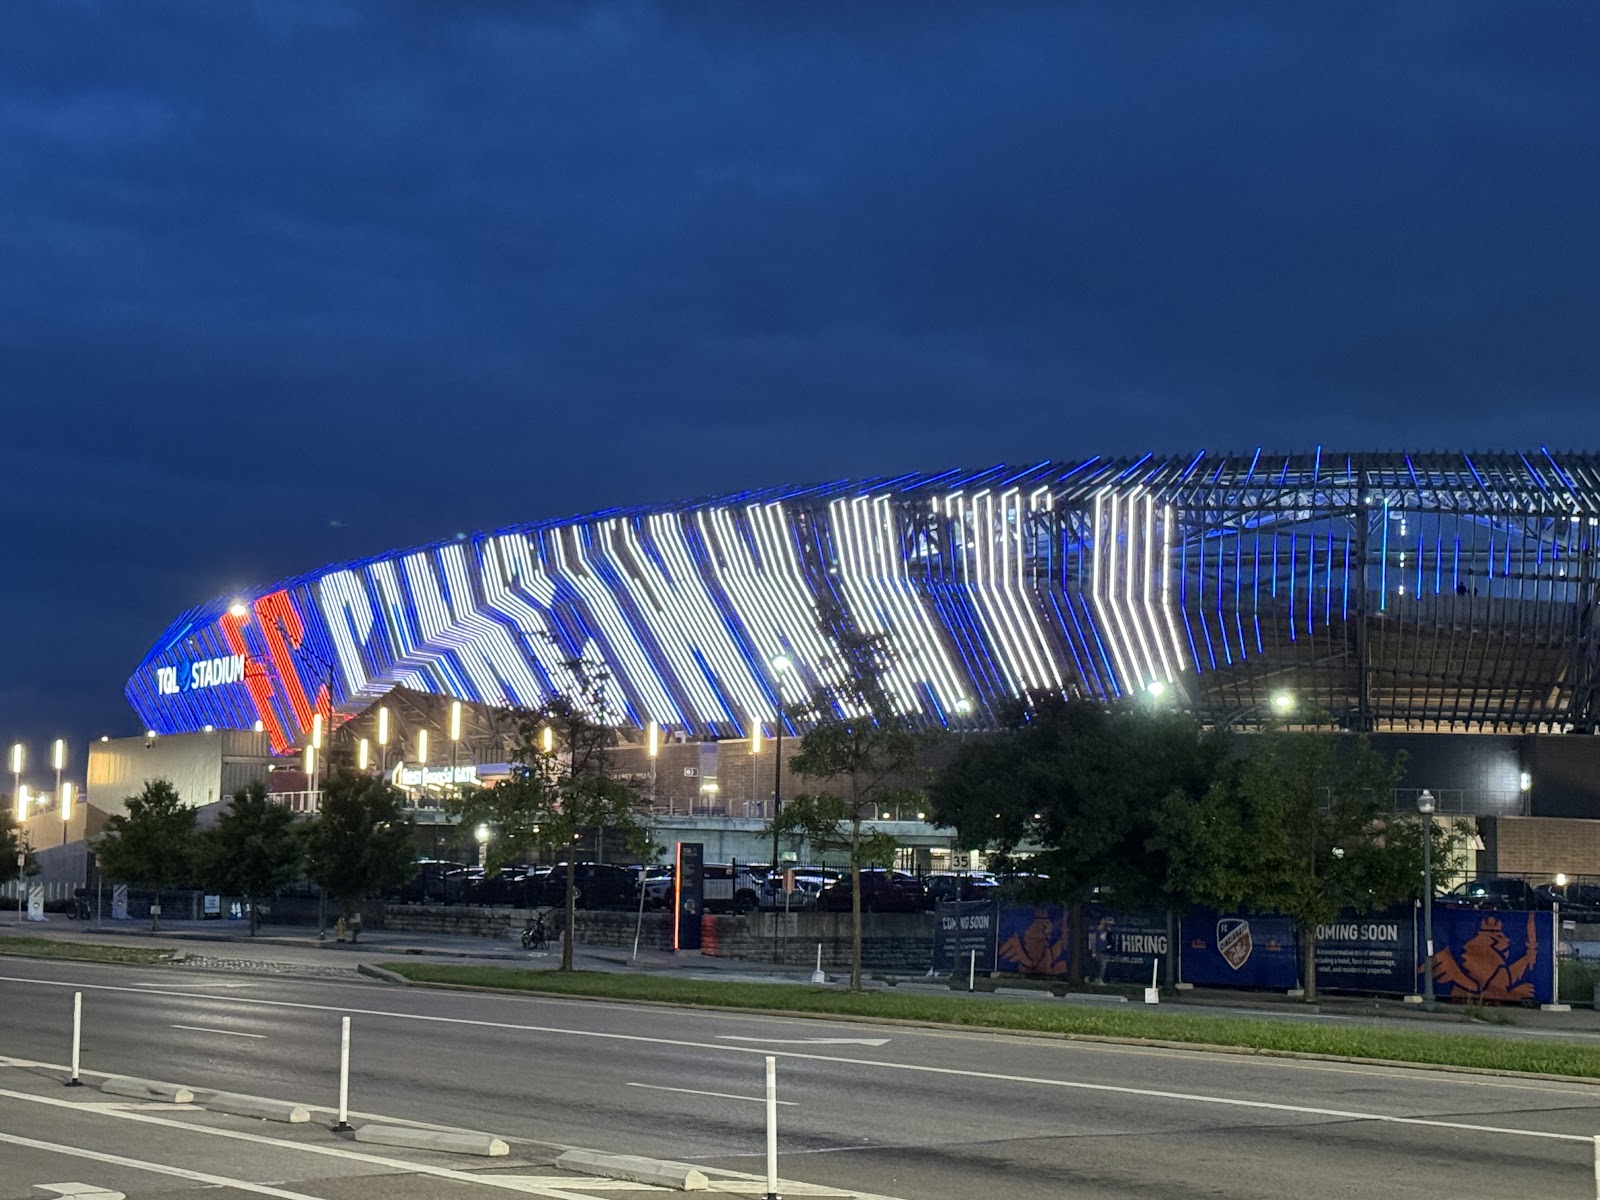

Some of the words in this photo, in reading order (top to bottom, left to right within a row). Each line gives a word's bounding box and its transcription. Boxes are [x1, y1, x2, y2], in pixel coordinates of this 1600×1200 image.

[157, 666, 179, 695] TQL
[191, 654, 245, 689] STADIUM
[953, 856, 968, 868] 35
[942, 917, 969, 930] COMNG
[969, 915, 989, 929] SOON
[1314, 924, 1358, 940] OMING
[1360, 924, 1397, 941] SOON
[1121, 934, 1167, 955] HIRING
